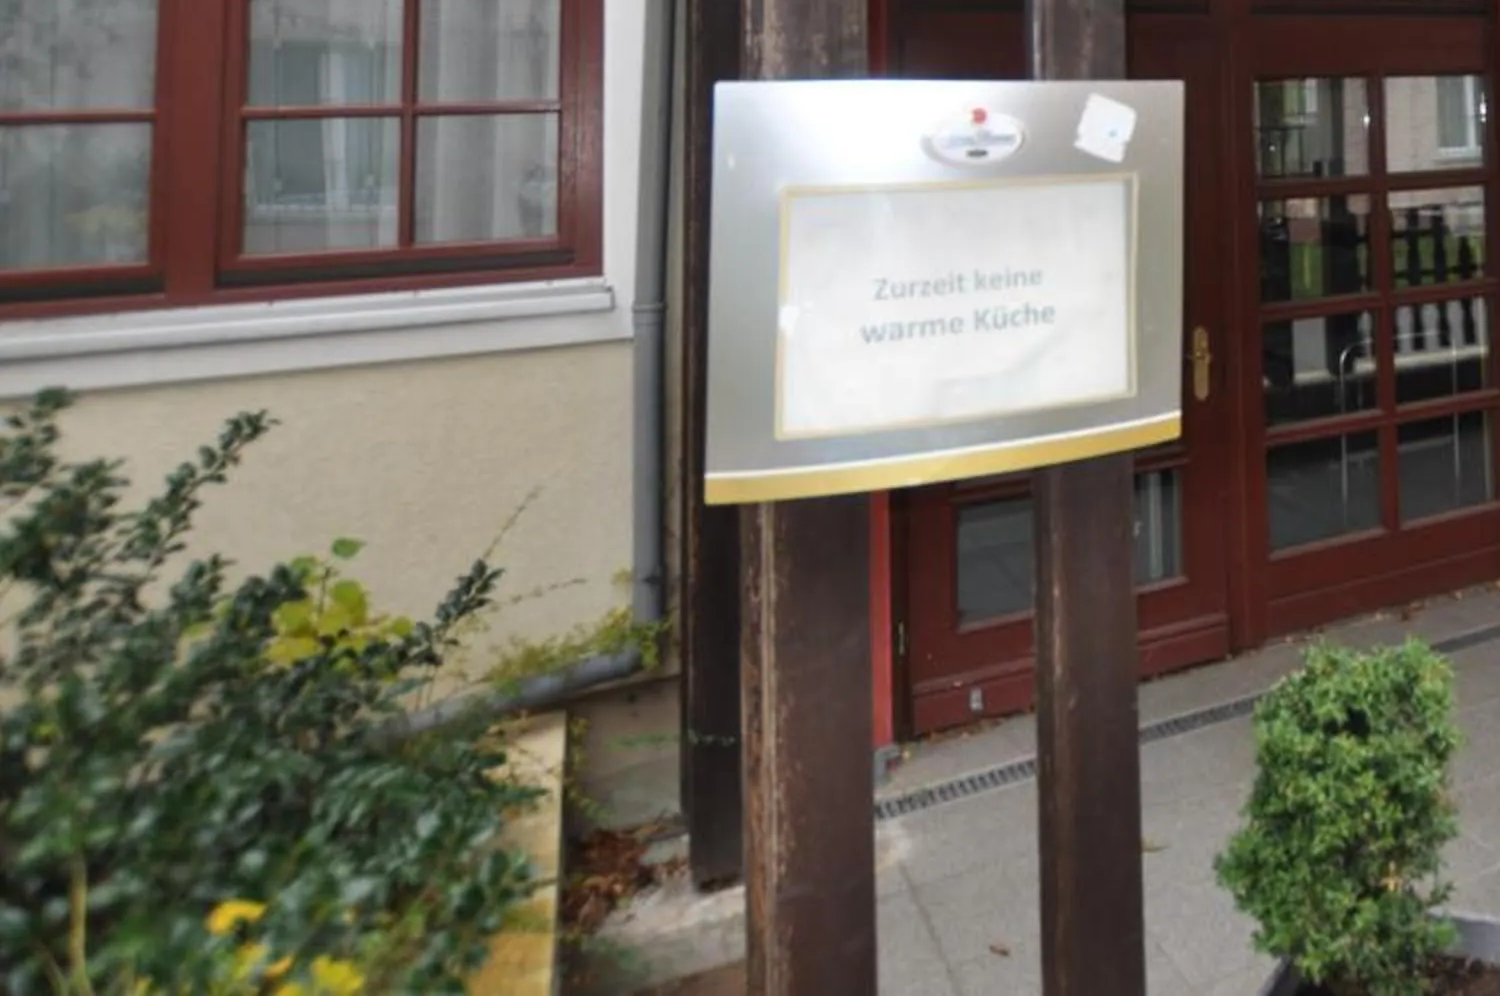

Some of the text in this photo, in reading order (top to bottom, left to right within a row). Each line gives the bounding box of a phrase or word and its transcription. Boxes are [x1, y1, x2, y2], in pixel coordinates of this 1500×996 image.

[873, 267, 1044, 301] Zurzeit keine
[860, 302, 1055, 344] warme Küche
